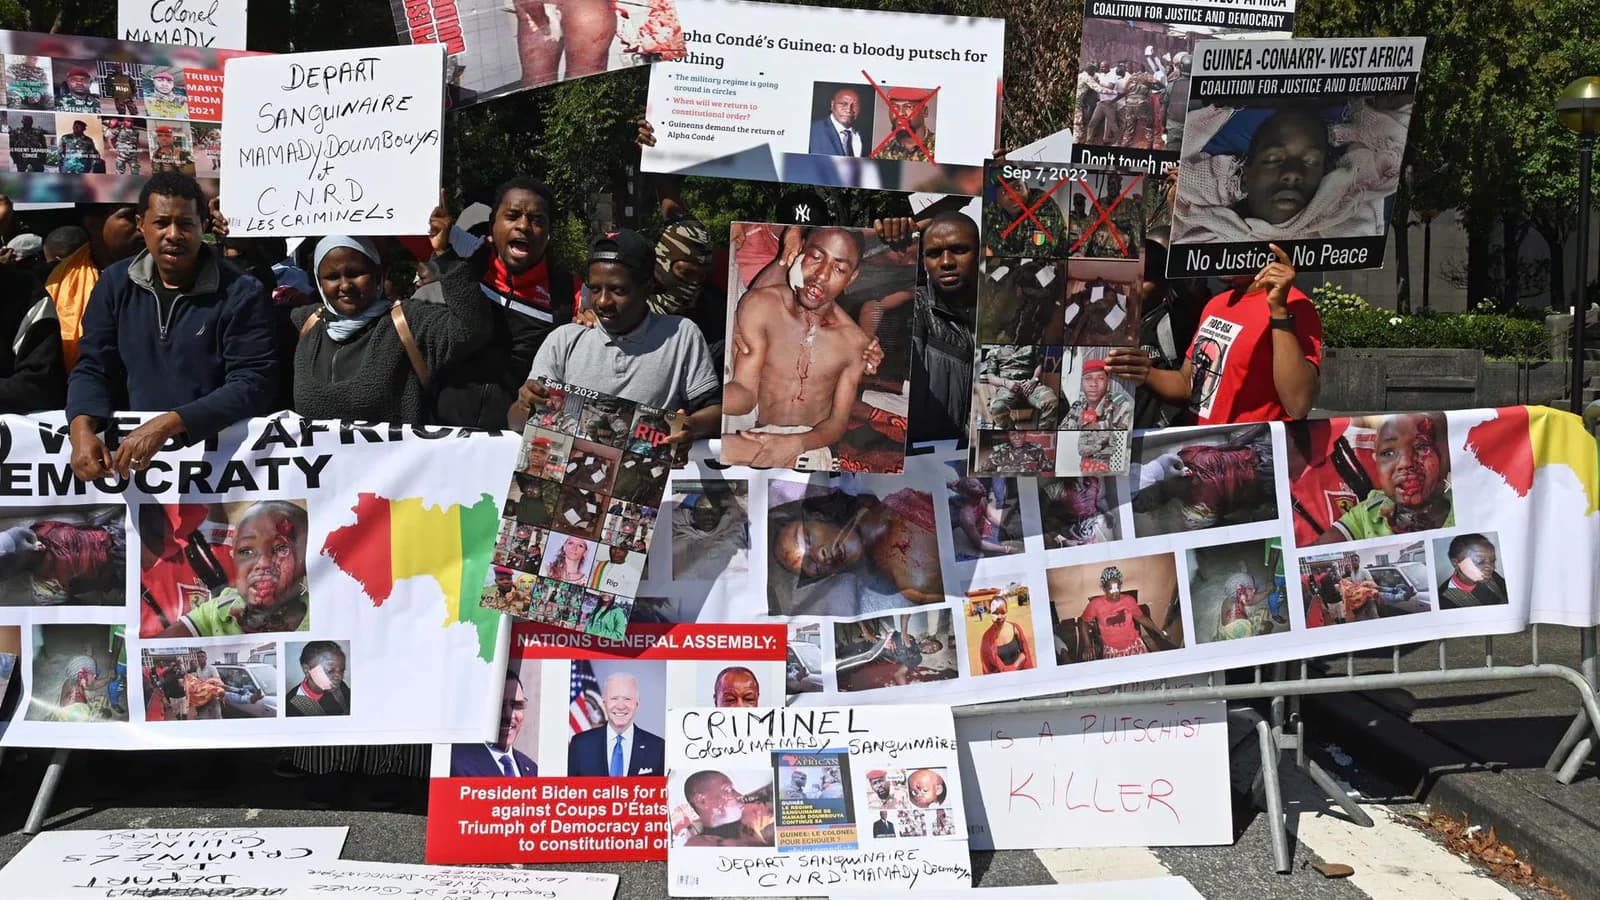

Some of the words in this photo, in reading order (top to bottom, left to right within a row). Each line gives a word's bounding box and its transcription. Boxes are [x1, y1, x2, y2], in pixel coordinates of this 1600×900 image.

[1093, 3, 1141, 17] COALITION
[1144, 7, 1162, 19] FOR
[1165, 9, 1202, 22] JUSTICE
[1205, 11, 1225, 24] AND
[1228, 12, 1285, 27] DEMOCRATY
[682, 30, 711, 43] pha
[716, 33, 774, 48] Condé's
[778, 38, 836, 53] Guinea:
[840, 44, 849, 54] a
[853, 42, 905, 60] bloody
[908, 48, 960, 61] putsch
[964, 49, 988, 62] for
[673, 51, 724, 69] othing
[1203, 49, 1252, 70] GUINEA
[1330, 46, 1367, 69] WEST
[1368, 46, 1414, 68] AFRICA
[281, 58, 381, 94] DEPART
[675, 73, 689, 82] The
[691, 74, 721, 85] military
[723, 78, 748, 87] regime
[750, 79, 756, 87] is
[757, 81, 779, 90] going
[1200, 79, 1255, 95] COALITION
[1258, 79, 1278, 94] FOR
[1280, 78, 1321, 93] JUSTICE
[1324, 77, 1345, 93] AND
[1349, 76, 1409, 92] DEMOCRATY
[674, 84, 701, 93] around
[703, 86, 711, 94] in
[712, 87, 737, 96] circles
[188, 96, 220, 104] FROM
[673, 96, 694, 106] When
[696, 98, 710, 106] will
[723, 102, 748, 110] return
[190, 107, 215, 115] 2021
[256, 94, 412, 134] SANGUINAIRE
[671, 108, 725, 119] constitutional
[726, 112, 750, 121] order?
[667, 131, 690, 140] Alpha
[691, 133, 715, 141] Condé
[668, 120, 704, 130] Guineans
[705, 123, 736, 132] demand
[737, 126, 749, 134] the
[751, 128, 775, 136] return
[318, 161, 334, 181] et
[1081, 149, 1115, 164] Don't
[1119, 154, 1156, 174] touch
[1002, 165, 1031, 182] Sep
[1035, 167, 1046, 182] 7,
[1050, 168, 1087, 182] 2022
[247, 216, 275, 231] LES
[281, 204, 394, 227] CRIMINELS
[1187, 249, 1210, 271] No
[1216, 248, 1276, 270] Justice
[1292, 245, 1315, 266] No
[1320, 244, 1368, 265] Peace
[544, 378, 562, 393] Sep
[574, 386, 599, 400] 2022
[634, 423, 667, 447] Rip
[606, 578, 619, 587] Rip
[517, 633, 592, 648] NATIONS
[597, 634, 679, 648] GENERAL
[682, 635, 777, 650] ASSEMBLY:
[682, 707, 870, 741] CRIMINEL
[989, 728, 1013, 749] IS
[1039, 721, 1054, 745] A
[1080, 712, 1205, 745] PUTSCHIST
[750, 737, 831, 756] MAMADY
[460, 786, 537, 800] President
[542, 786, 587, 800] Biden
[592, 785, 629, 799] calls
[633, 785, 656, 799] for
[1009, 764, 1181, 825] KILLER
[491, 803, 551, 820] against
[555, 802, 607, 819] Coups
[612, 798, 668, 816] D'États
[458, 820, 524, 837] Triumph
[530, 820, 547, 833] of
[551, 820, 640, 836] Democracy
[519, 838, 534, 851] to
[540, 836, 648, 851] constitutional
[716, 856, 790, 875] DEPART
